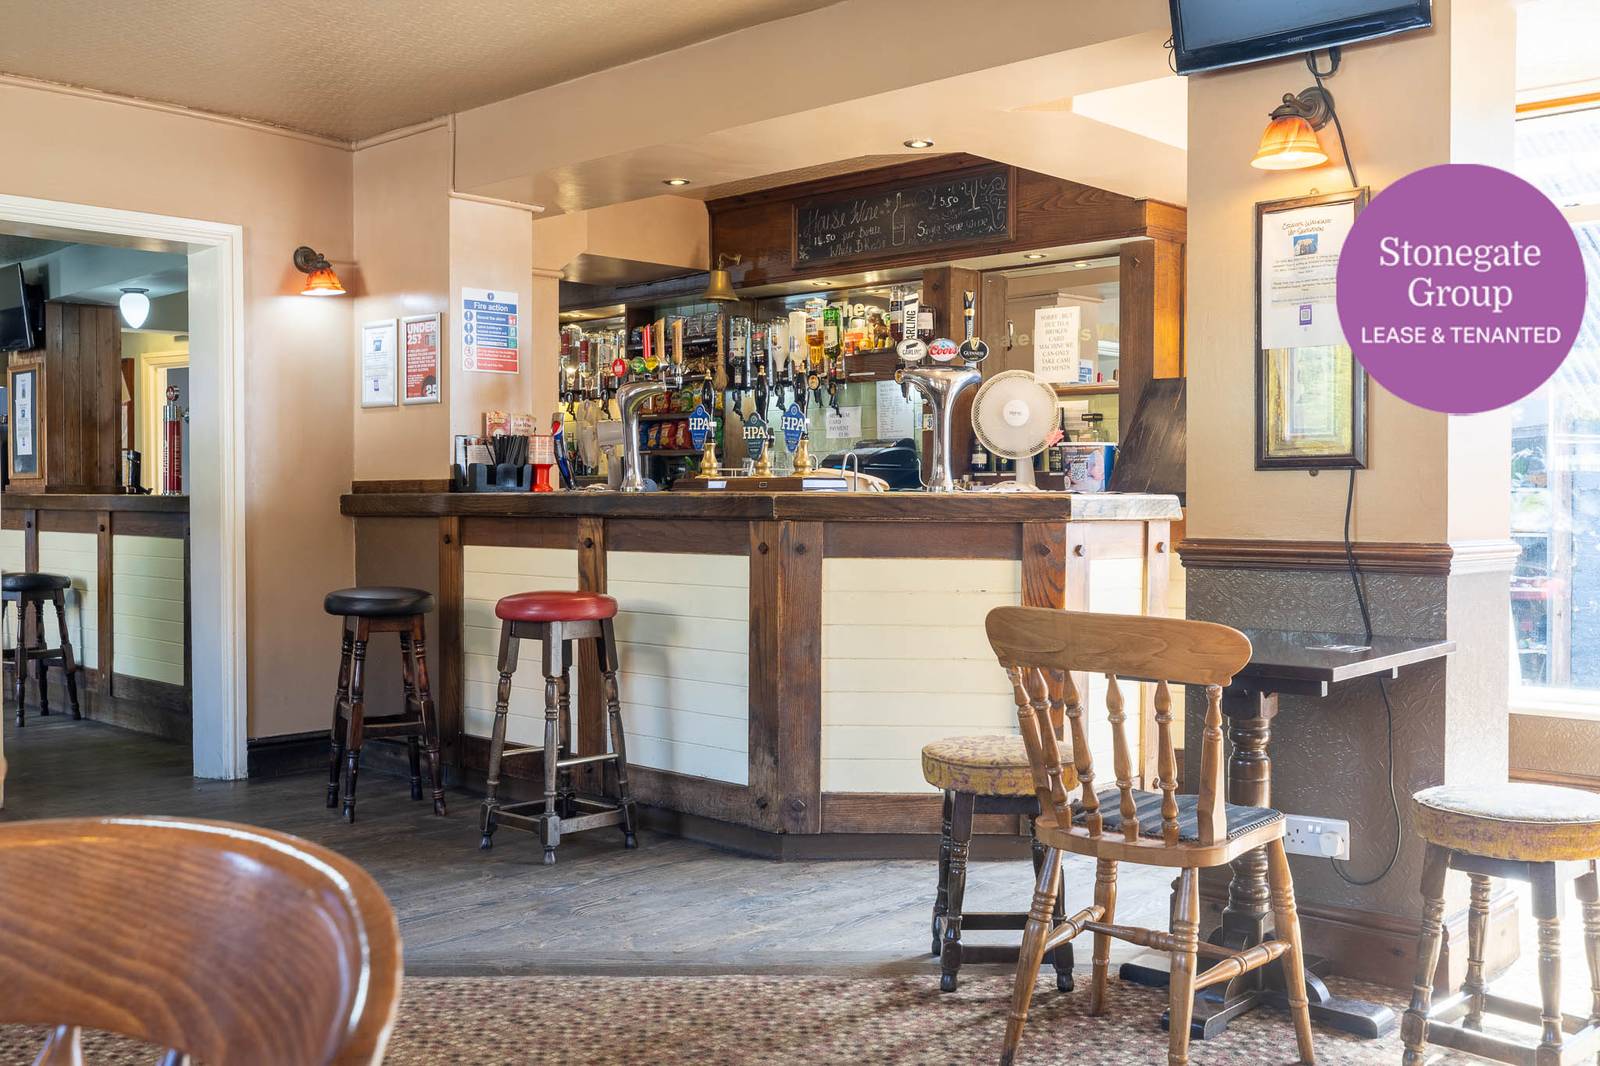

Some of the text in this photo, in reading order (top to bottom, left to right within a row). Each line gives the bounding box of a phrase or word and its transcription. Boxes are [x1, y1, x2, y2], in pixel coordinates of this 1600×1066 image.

[473, 301, 509, 312] Fire action
[928, 343, 958, 356] Coors
[688, 417, 710, 431] HPA
[781, 416, 806, 431] HPA
[742, 426, 766, 440] HPA
